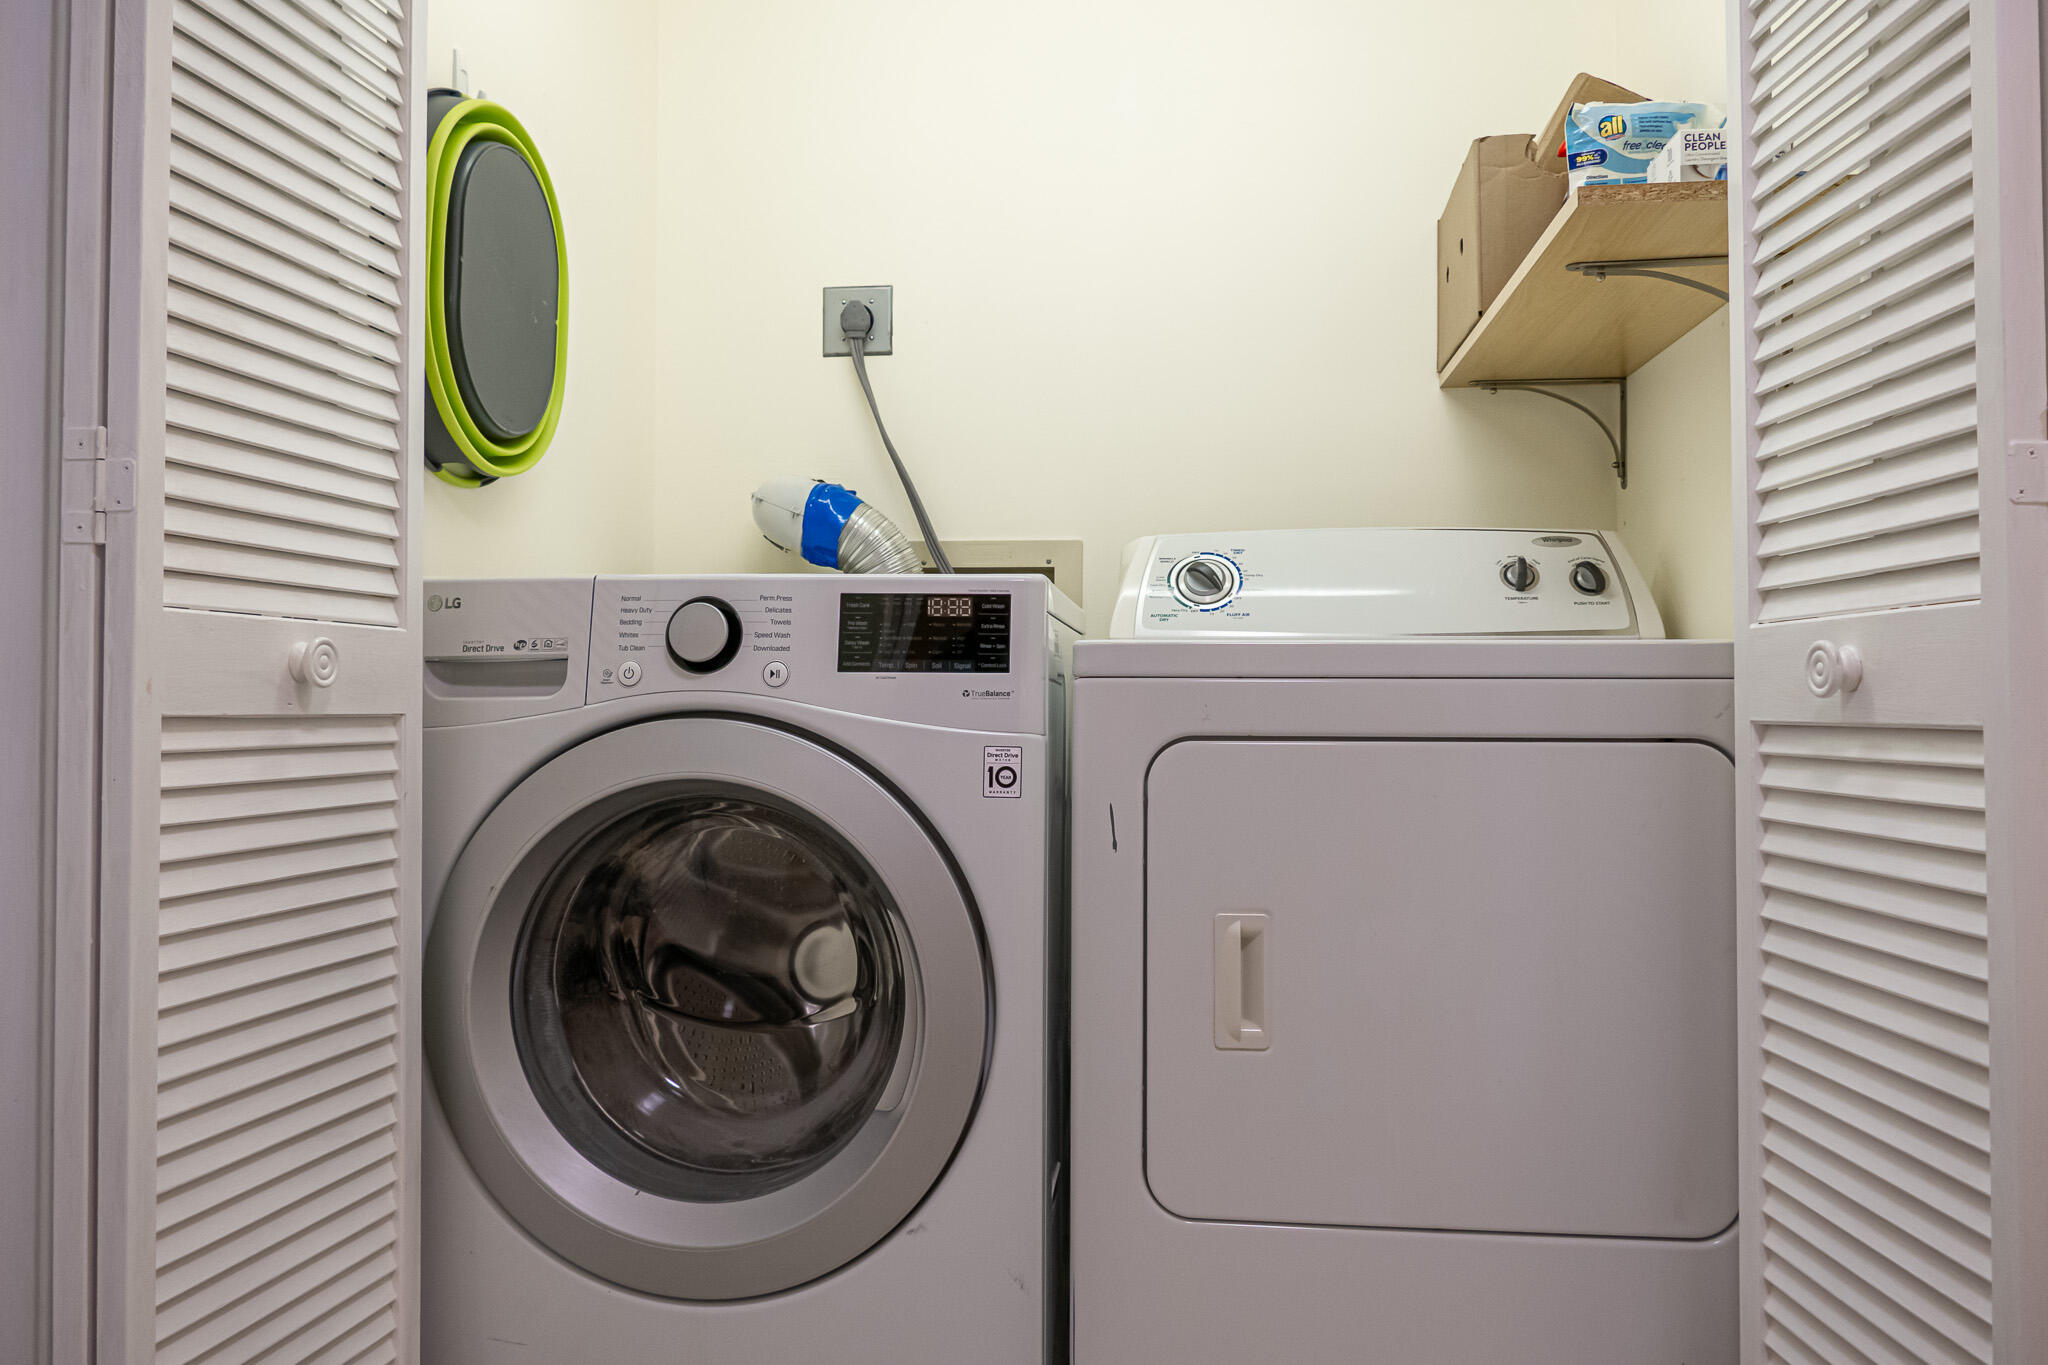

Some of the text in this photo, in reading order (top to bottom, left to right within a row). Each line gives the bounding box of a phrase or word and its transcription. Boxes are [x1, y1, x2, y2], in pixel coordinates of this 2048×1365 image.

[1600, 115, 1623, 138] all
[1684, 132, 1721, 142] CLEAN
[1623, 140, 1642, 150] free
[1684, 141, 1727, 151] PEOPLE
[1576, 154, 1594, 163] 99%
[444, 597, 462, 609] LG
[754, 631, 791, 639] Speed Wash
[462, 644, 505, 653] Direct Drive
[987, 766, 1017, 789] 10
